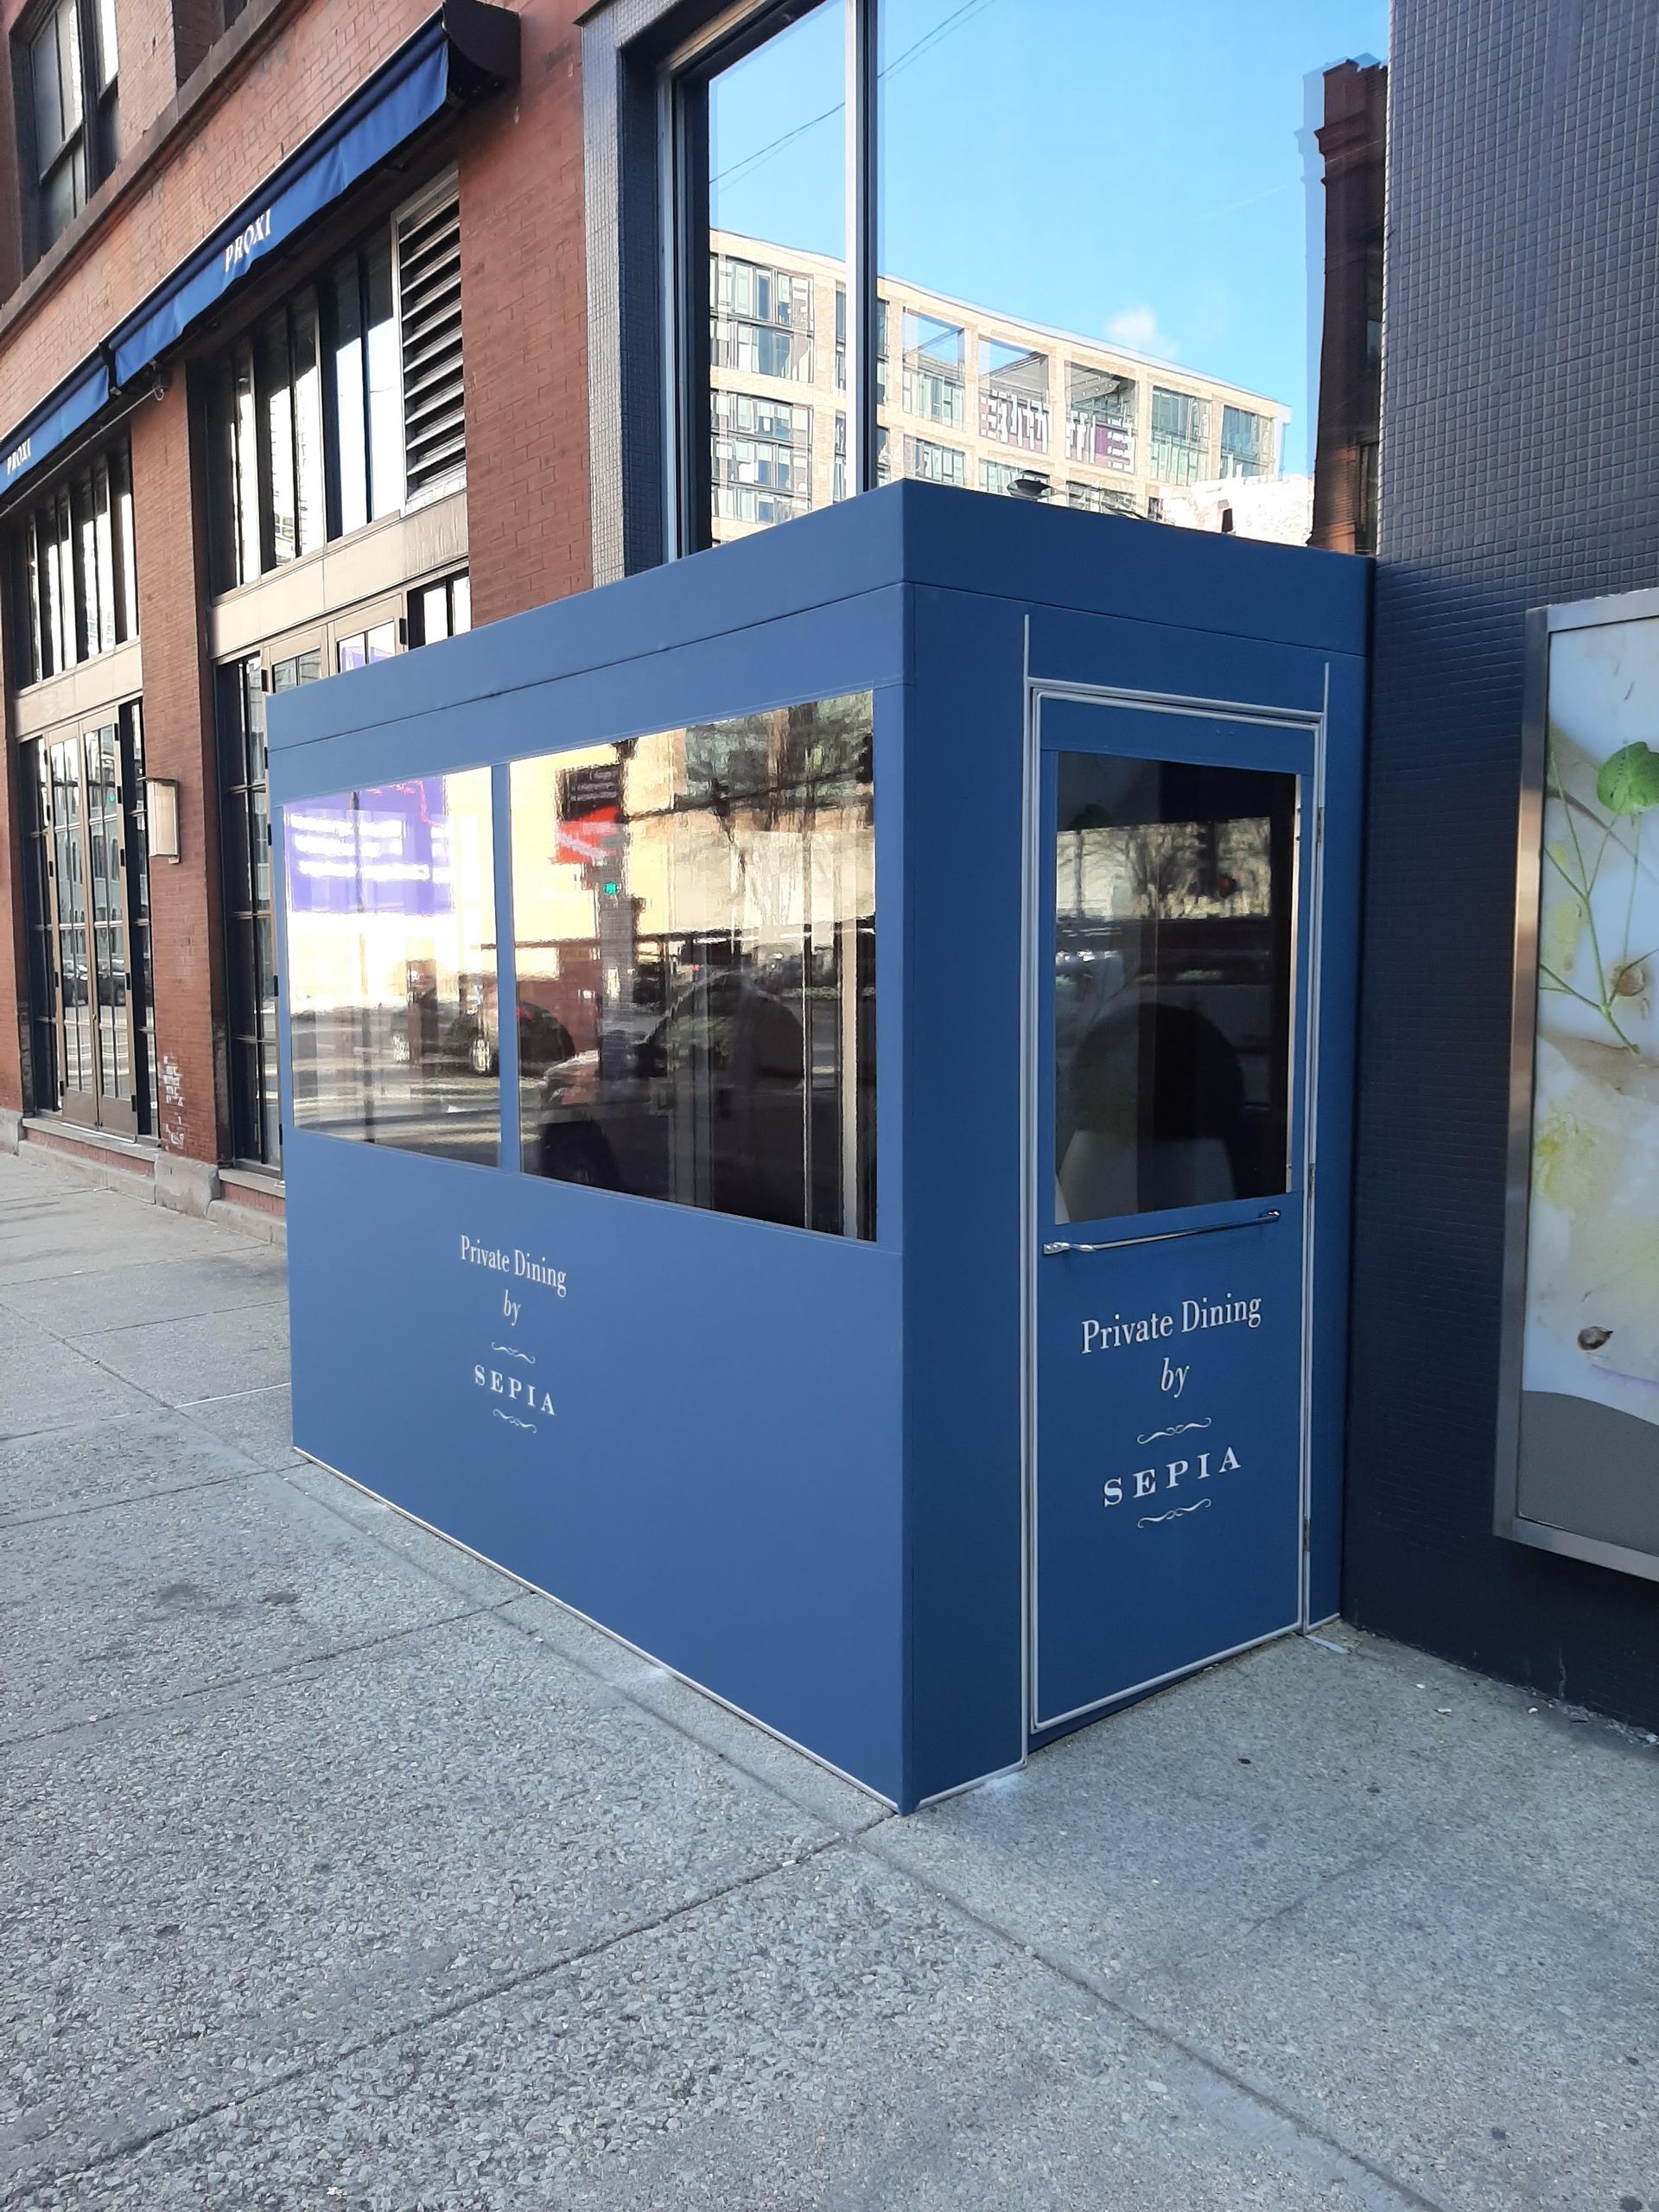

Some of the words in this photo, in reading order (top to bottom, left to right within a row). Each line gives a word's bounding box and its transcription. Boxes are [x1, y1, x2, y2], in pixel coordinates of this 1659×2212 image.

[225, 208, 271, 273] PROXI
[460, 1234, 510, 1273] Private
[514, 1249, 567, 1298] Dining
[503, 1288, 521, 1326] by
[1081, 1313, 1173, 1354] Private
[1180, 1293, 1262, 1333] Dining
[474, 1363, 556, 1416] SEPIA
[1160, 1357, 1190, 1398] by
[1103, 1446, 1241, 1507] SEPIA
